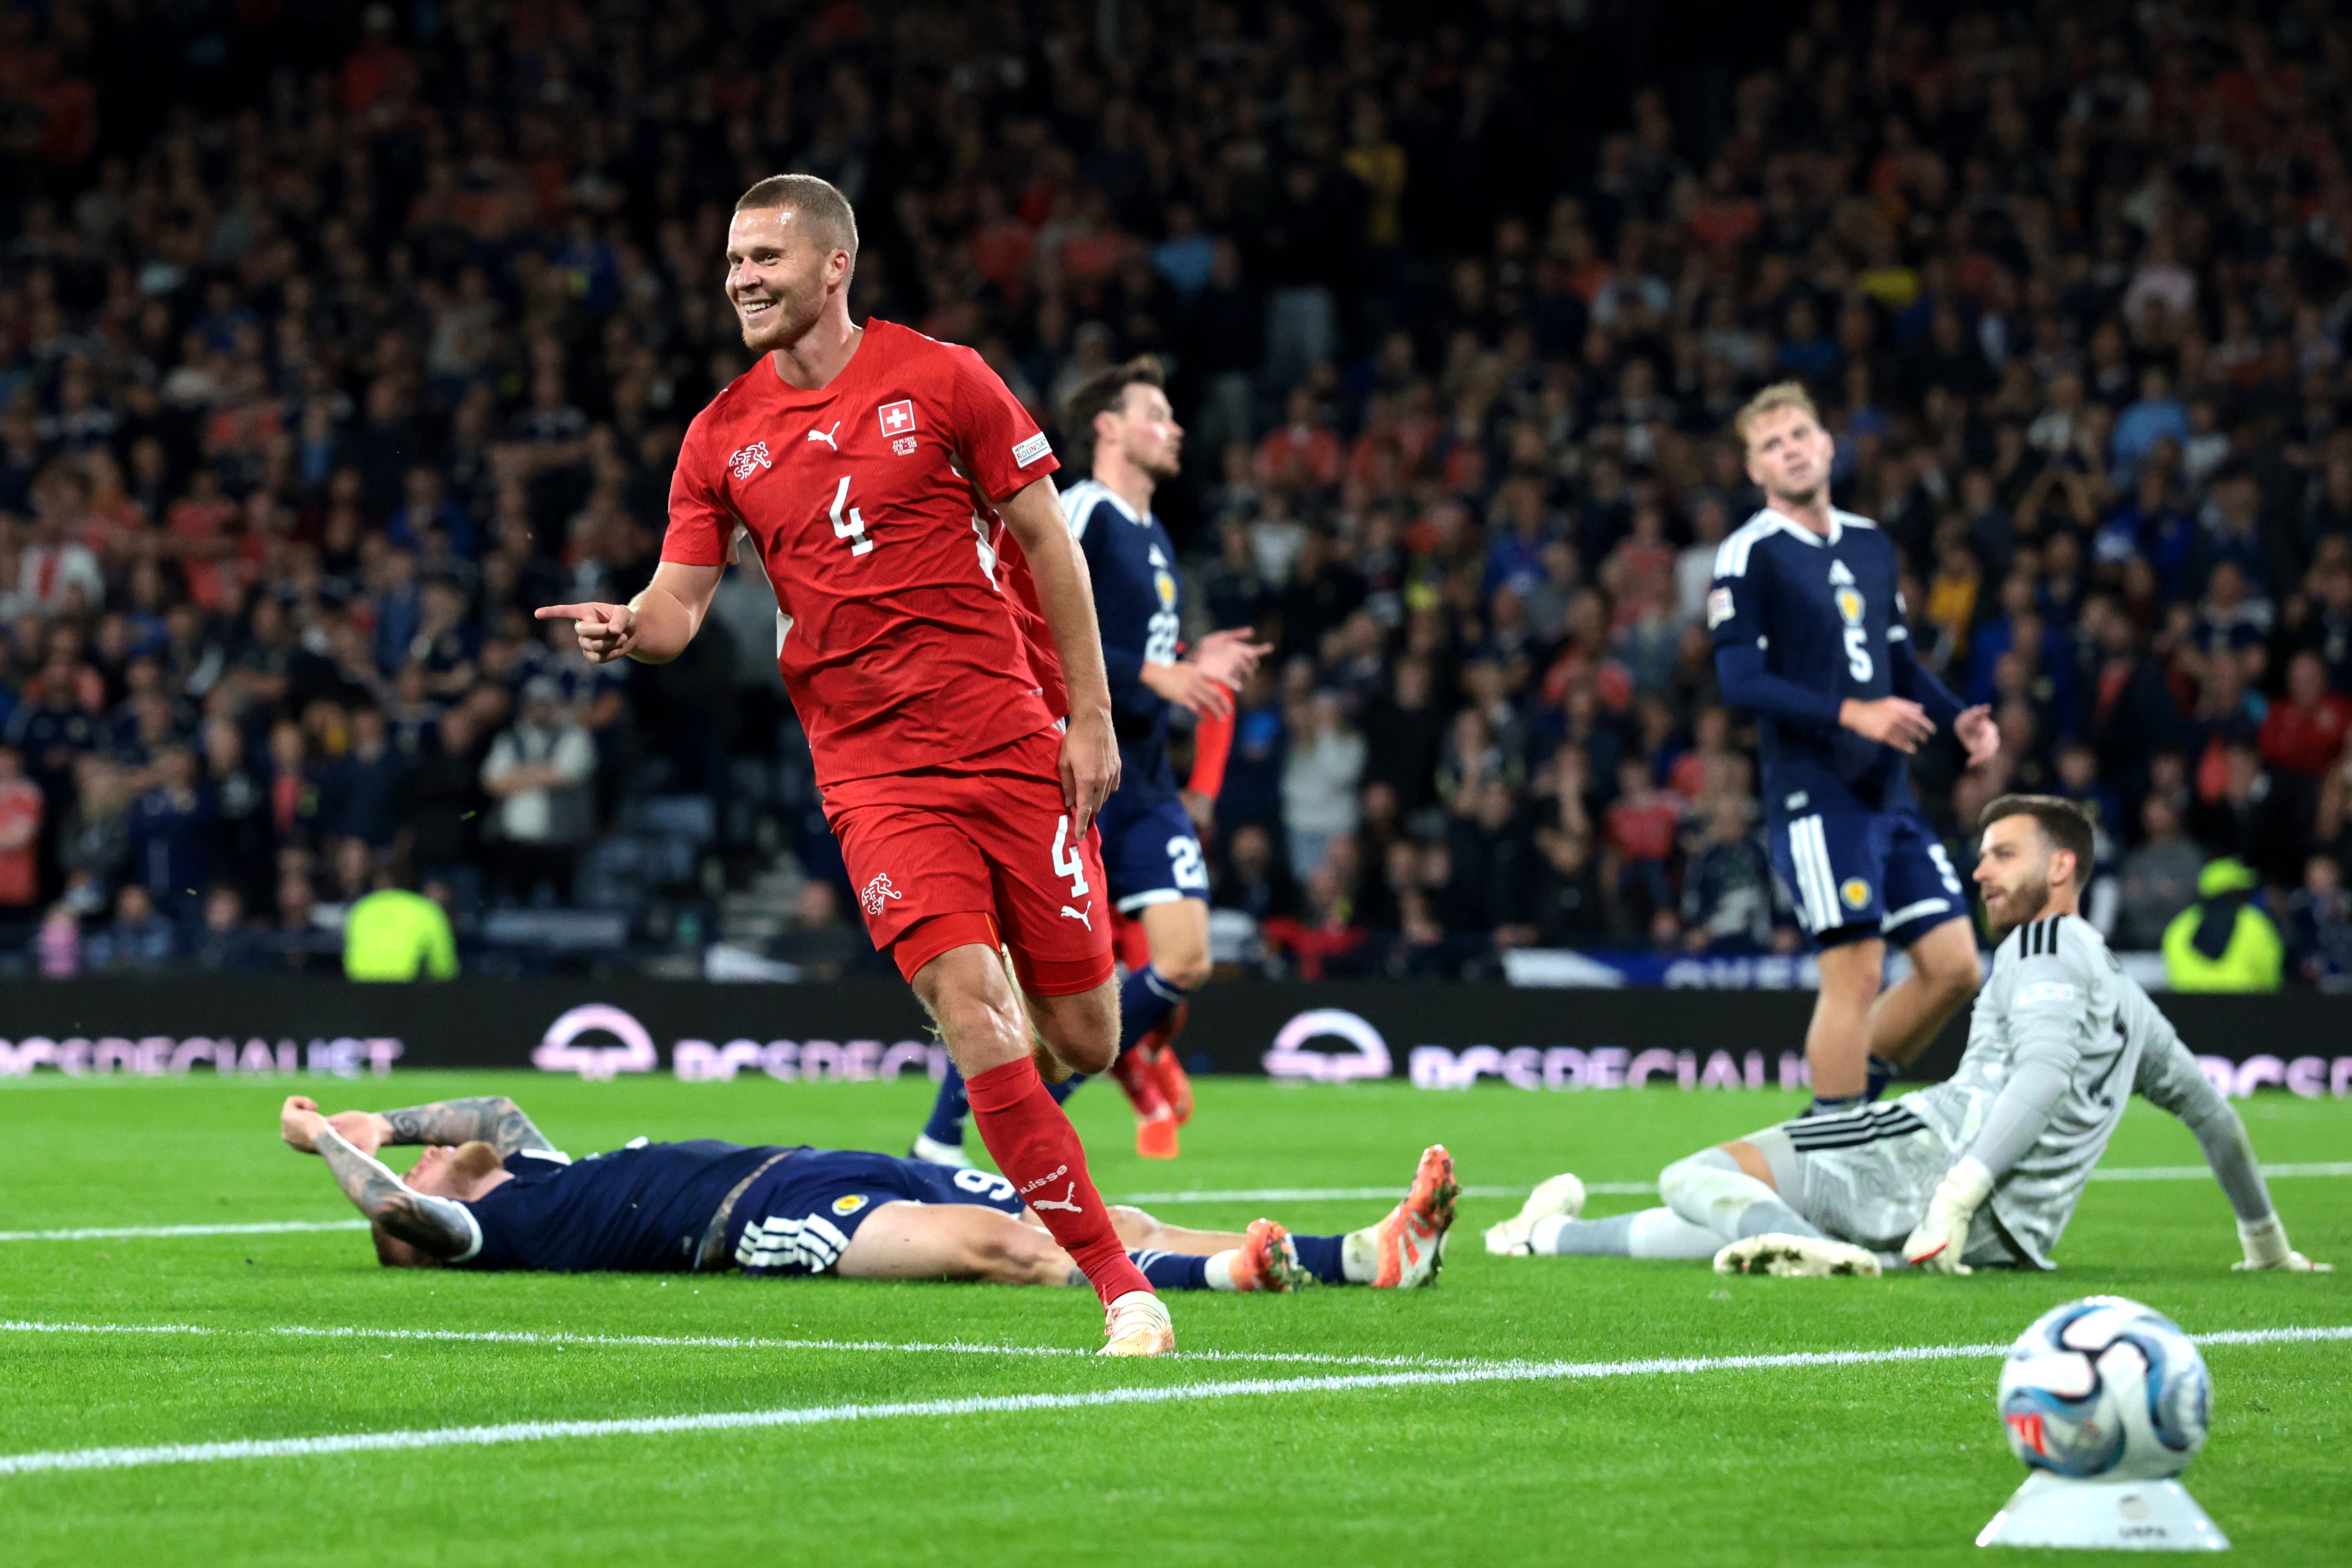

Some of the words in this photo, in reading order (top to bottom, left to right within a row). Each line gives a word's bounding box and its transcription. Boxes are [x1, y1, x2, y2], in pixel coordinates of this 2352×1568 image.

[892, 443, 904, 452] SCO
[908, 440, 917, 448] SUI
[1014, 445, 1024, 453] UEFA
[829, 475, 873, 557] 4
[1844, 627, 1874, 683] 5
[1052, 814, 1089, 898] 4
[953, 1169, 1016, 1201] 9
